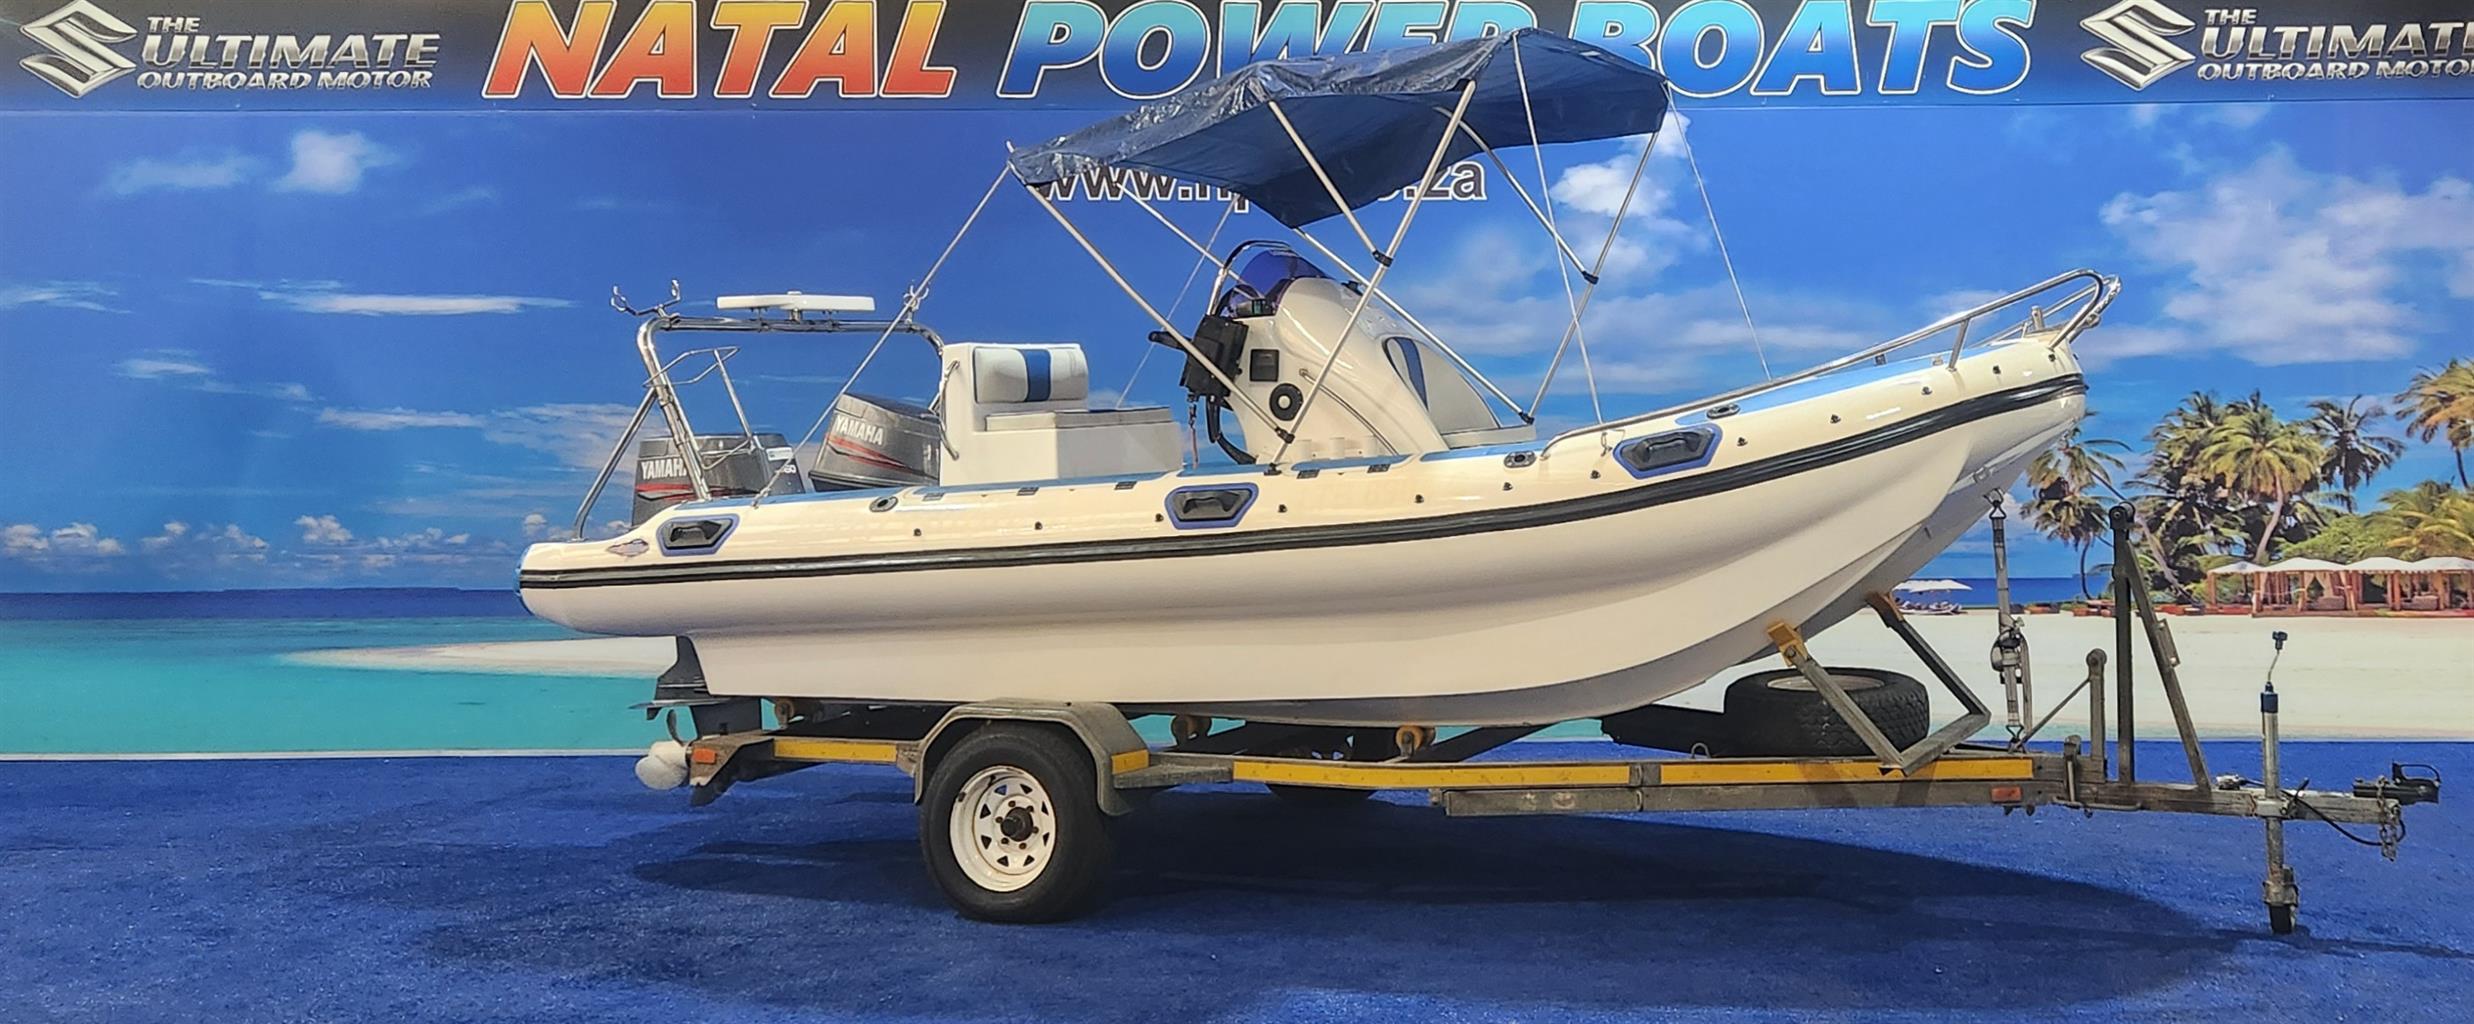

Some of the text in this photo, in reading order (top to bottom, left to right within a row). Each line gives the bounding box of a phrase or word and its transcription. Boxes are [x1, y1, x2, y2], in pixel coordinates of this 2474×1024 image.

[148, 16, 200, 33] THE
[2204, 8, 2257, 25] THE
[142, 33, 441, 69] ULTIMATE
[483, 0, 957, 98] NATAL
[1568, 0, 2035, 98] BOATS
[136, 70, 432, 90] OUTBOARD MOTOR
[2197, 59, 2474, 81] OUTBOARD MOTO
[835, 414, 884, 446] YAMAHA
